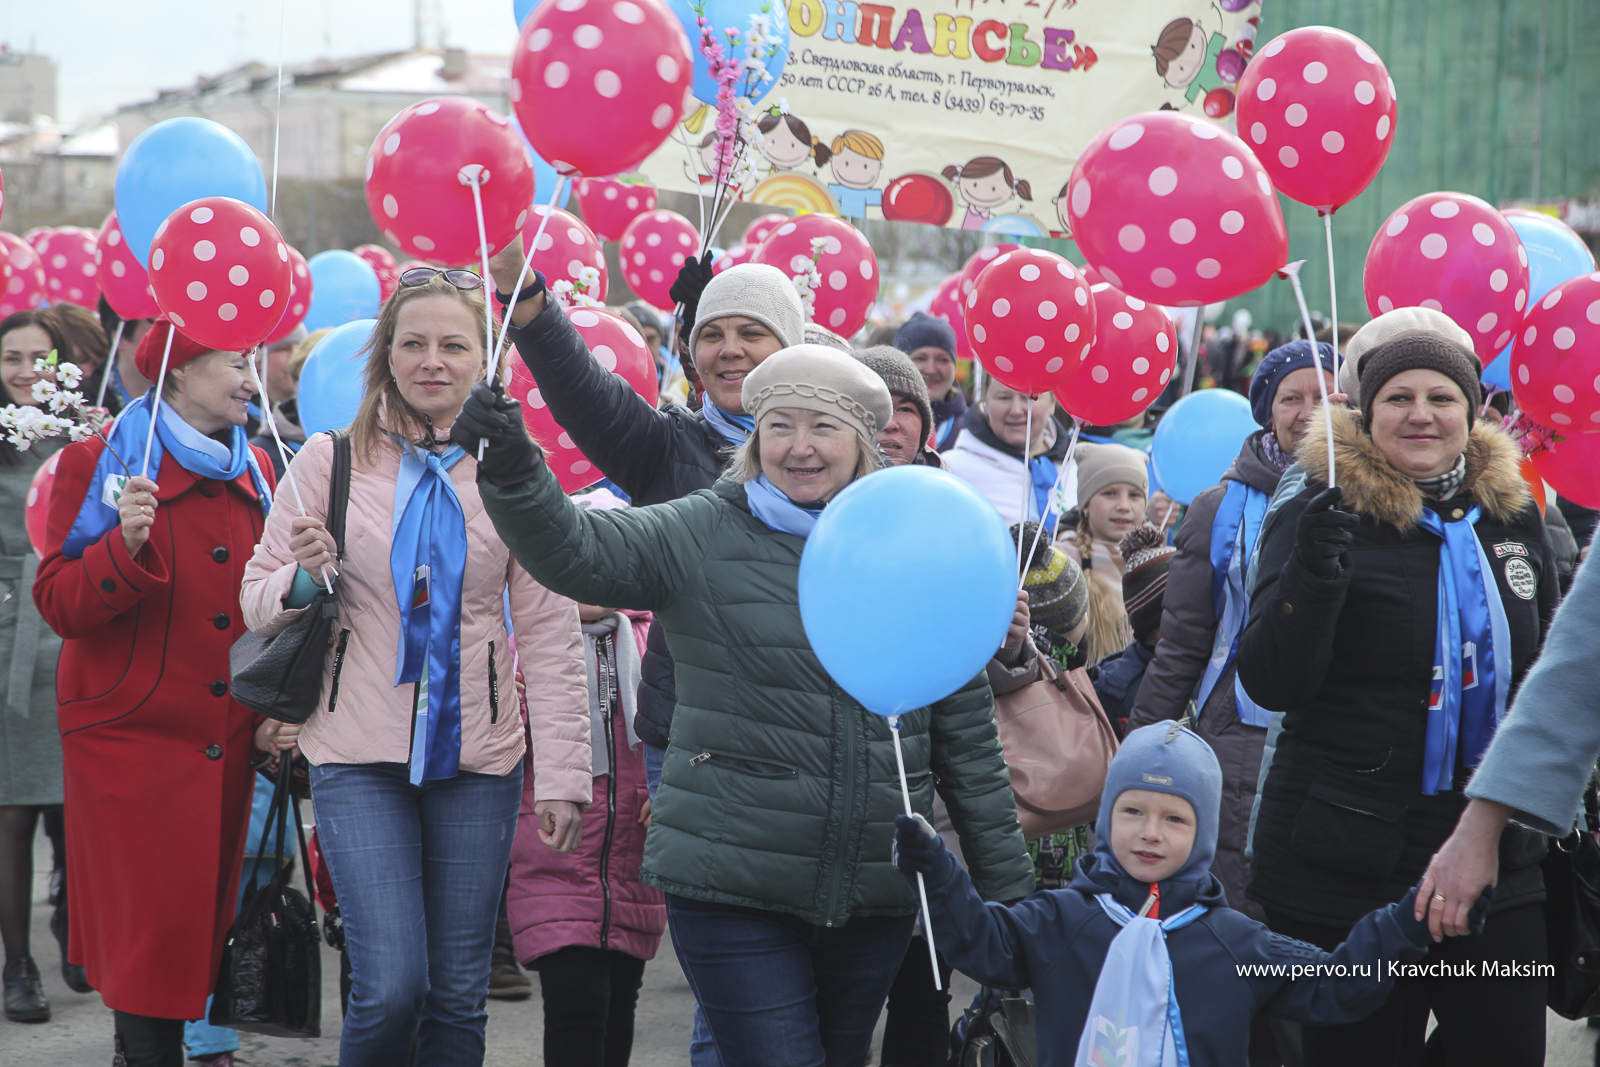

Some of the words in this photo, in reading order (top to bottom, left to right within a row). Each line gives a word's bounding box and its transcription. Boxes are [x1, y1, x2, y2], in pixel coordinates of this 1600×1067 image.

[798, 75, 823, 89] лет
[828, 74, 866, 94] СССР
[868, 83, 882, 97] 26
[901, 89, 928, 104] тел.
[932, 90, 941, 105] 8
[944, 90, 986, 115] (3439)
[989, 97, 1045, 121] 63-70-35
[802, 49, 885, 76] Свердловская
[888, 62, 944, 86] область,
[948, 73, 956, 85] г.
[961, 71, 1055, 99] Первоуральск,
